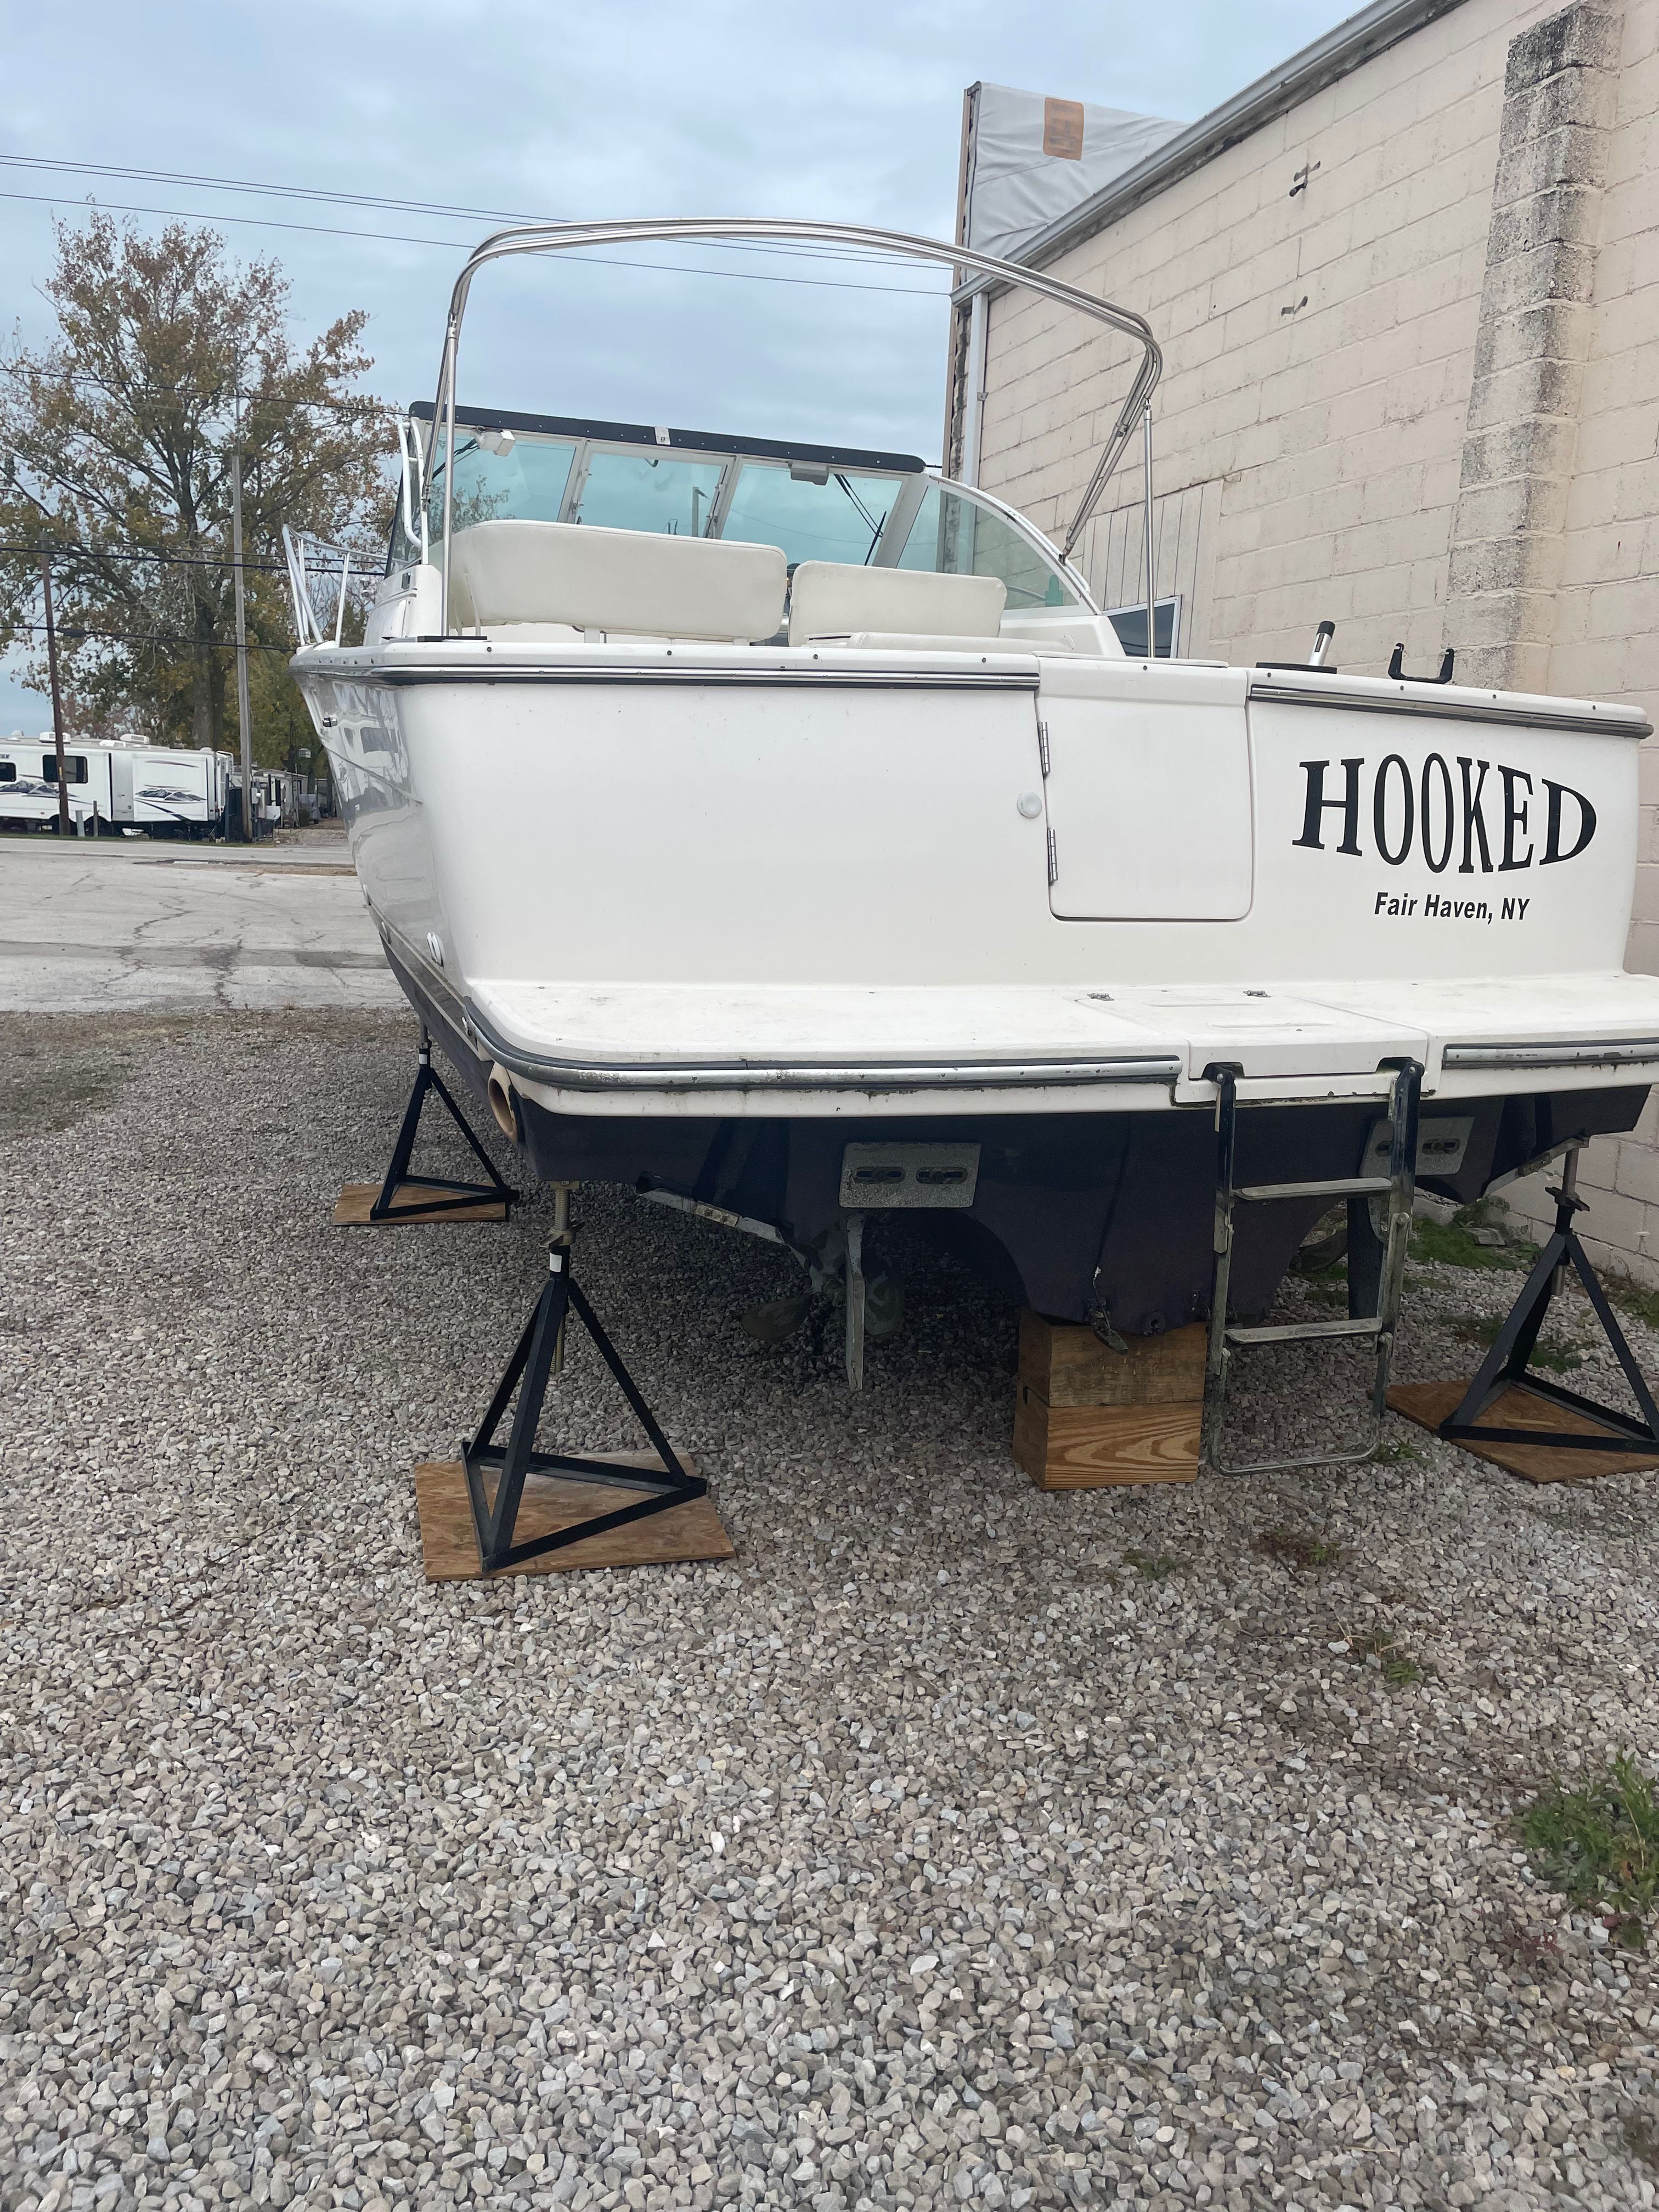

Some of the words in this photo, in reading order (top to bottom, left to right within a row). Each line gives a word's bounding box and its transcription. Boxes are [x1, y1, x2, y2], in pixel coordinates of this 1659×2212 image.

[1292, 752, 1597, 873] HOOKED
[1374, 892, 1418, 916] Fair
[1424, 894, 1493, 925] Haven,
[1501, 898, 1530, 920] NY
